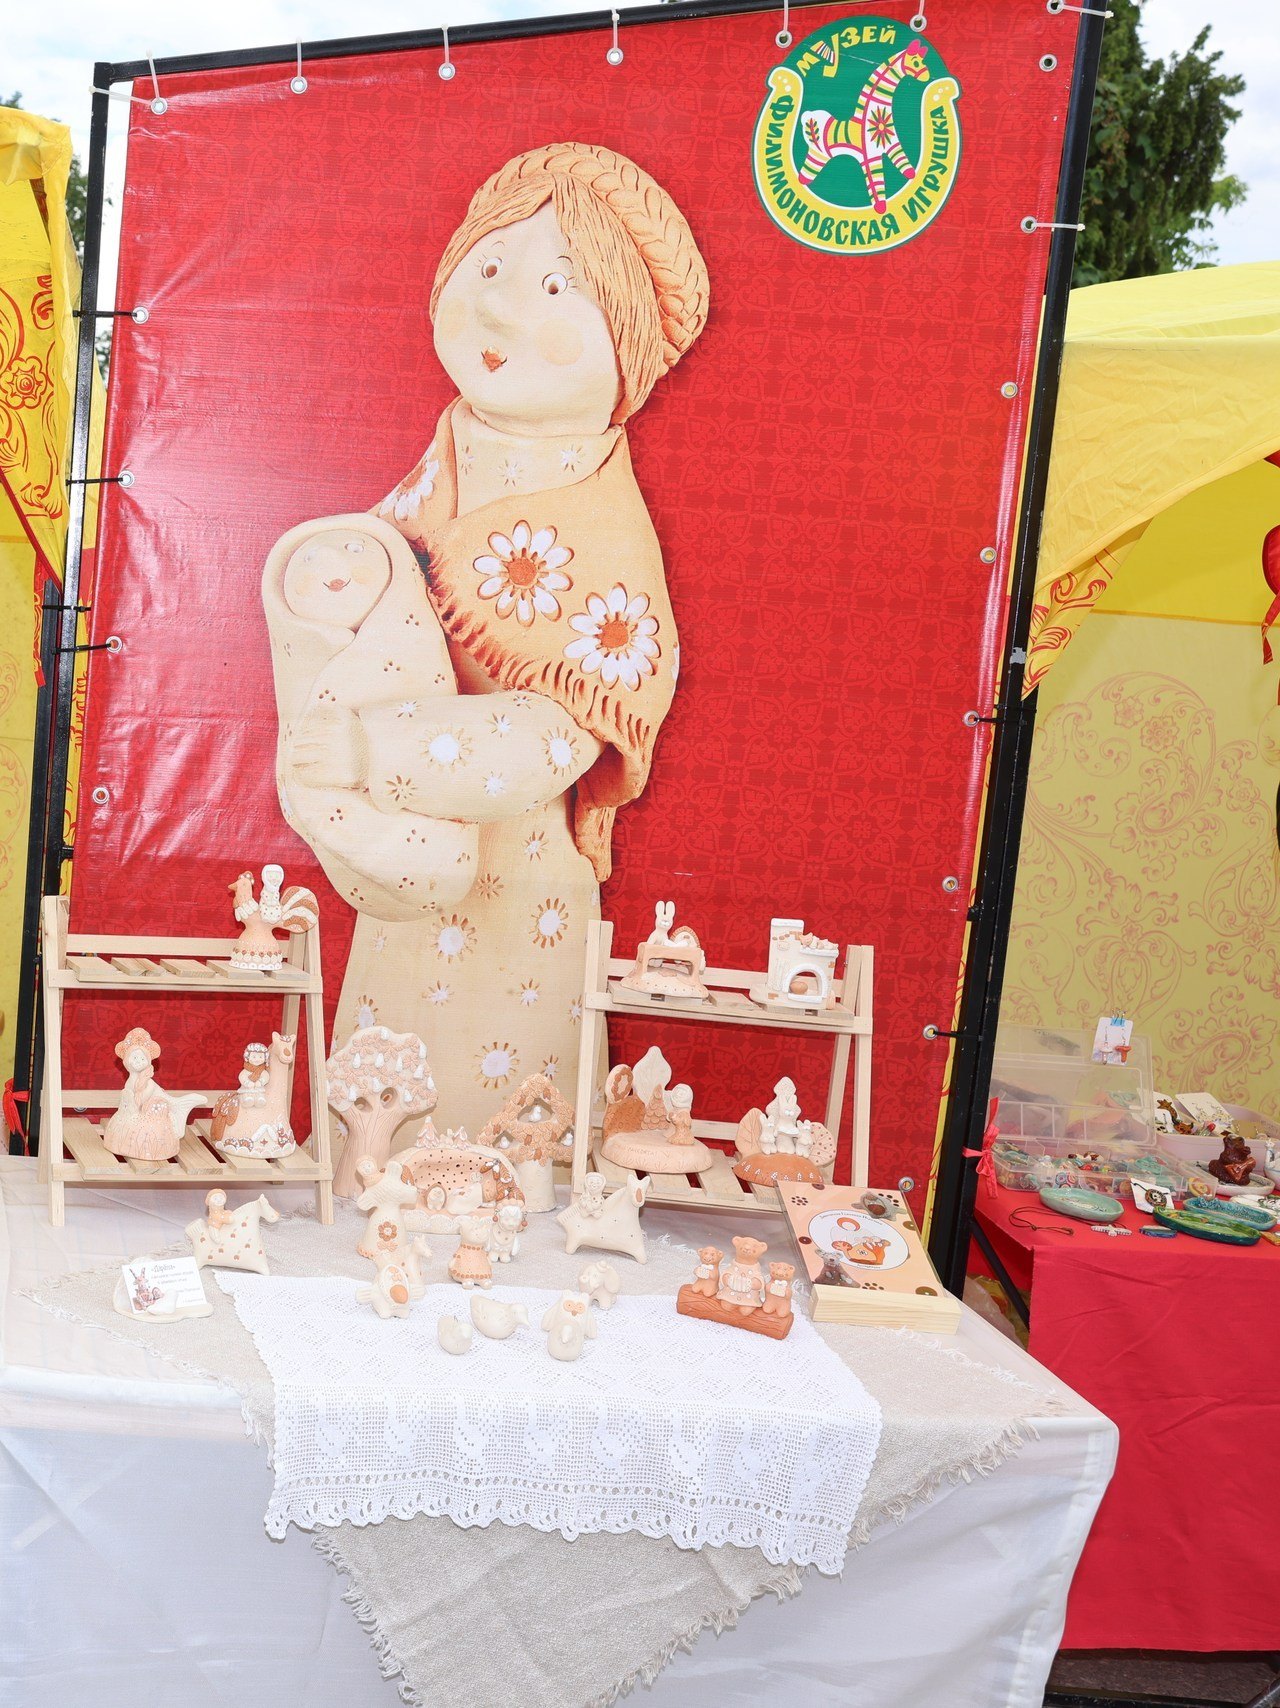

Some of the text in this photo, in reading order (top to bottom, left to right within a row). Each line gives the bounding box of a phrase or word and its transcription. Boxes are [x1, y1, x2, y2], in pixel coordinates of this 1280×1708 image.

[796, 25, 896, 78] МУЗЕЙ
[765, 95, 950, 246] ФИЛИМОНОВСКАЯ ИГРУШКА
